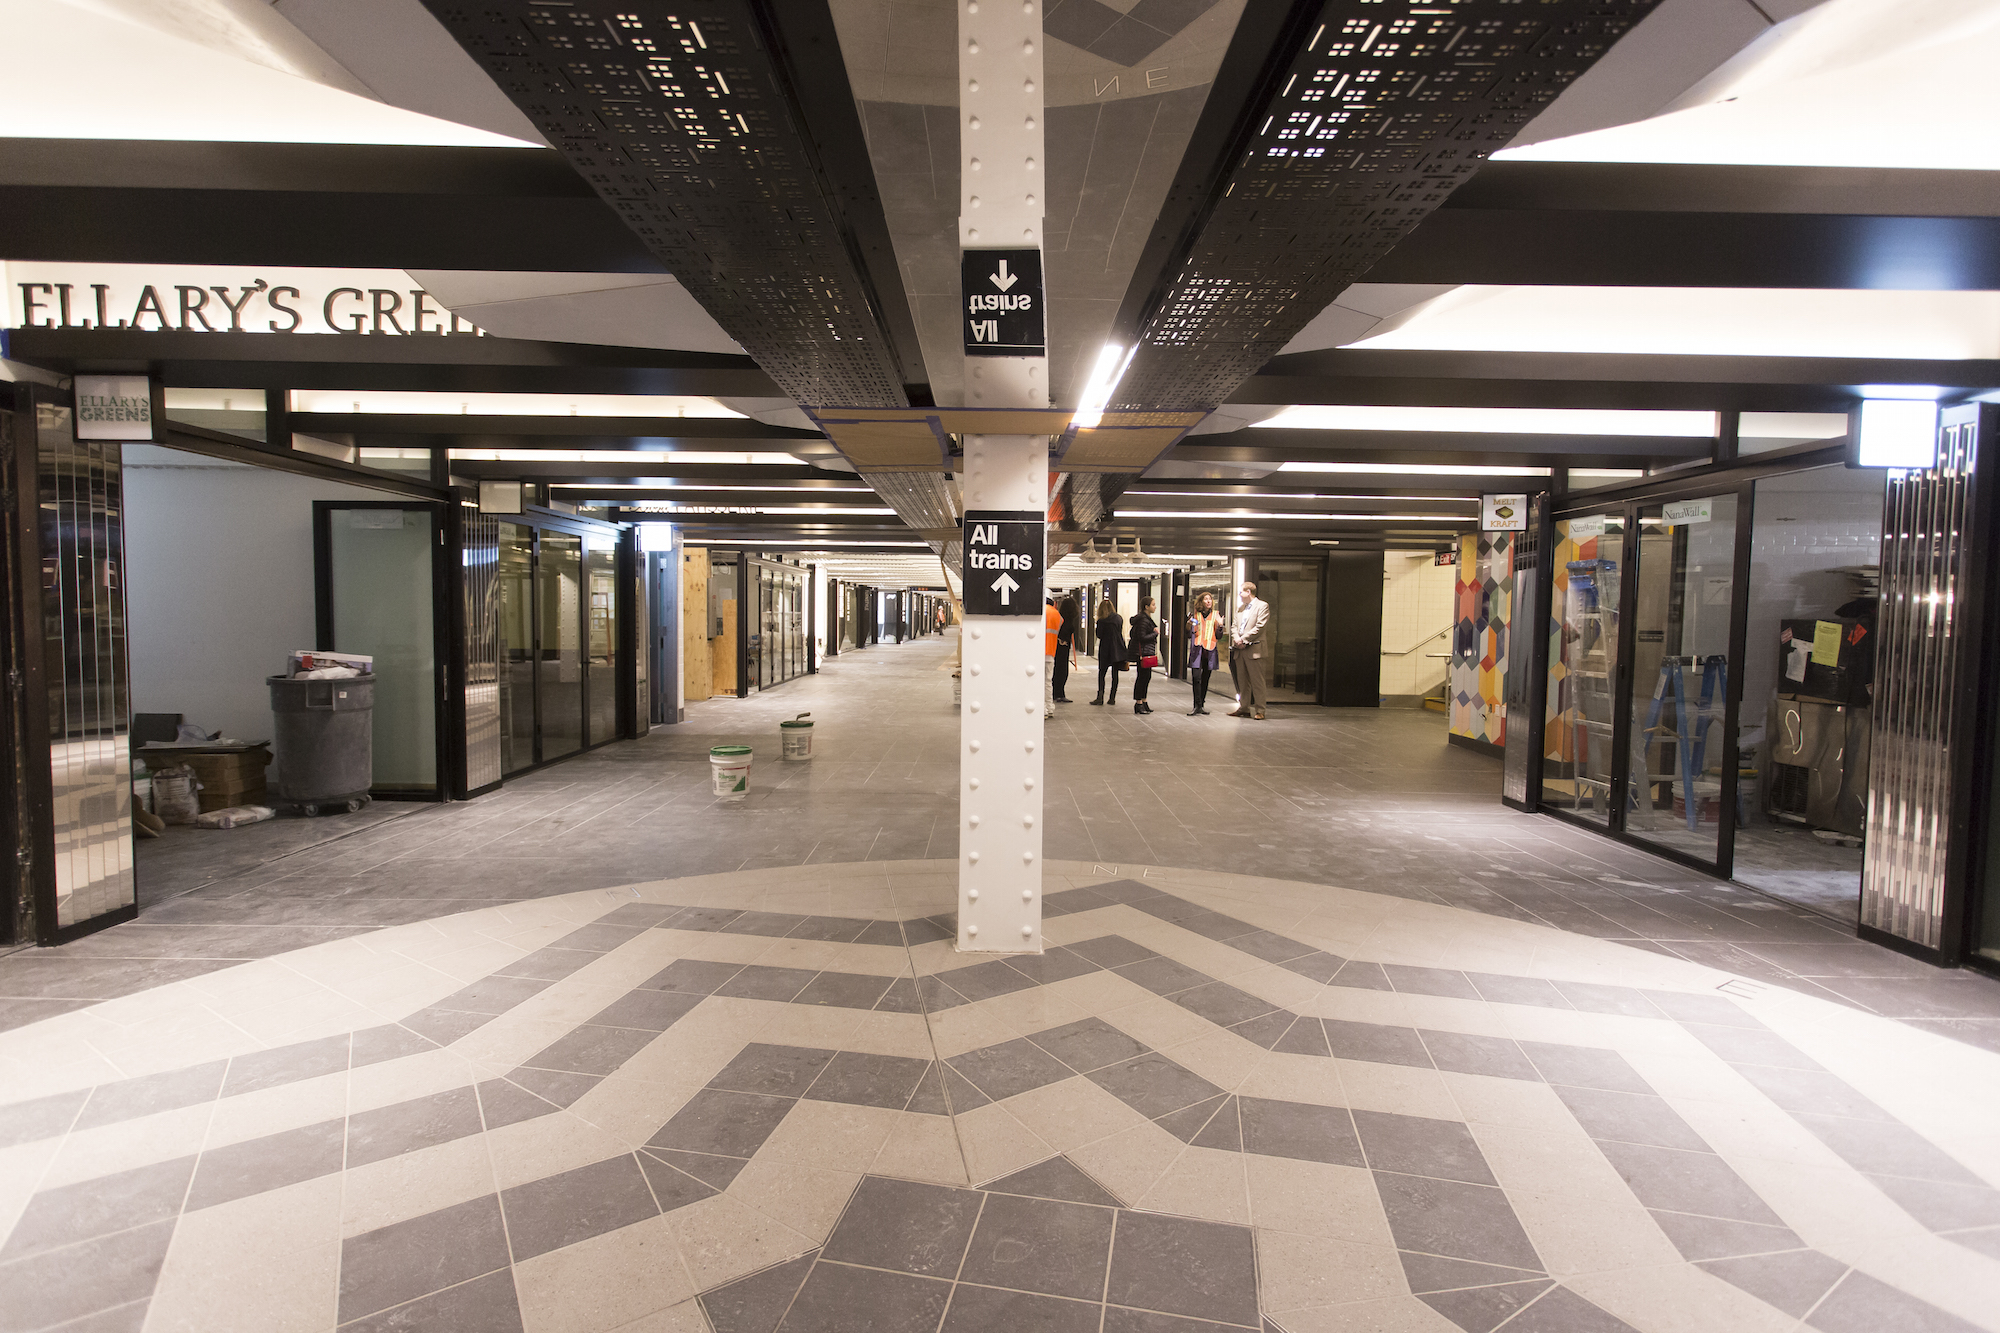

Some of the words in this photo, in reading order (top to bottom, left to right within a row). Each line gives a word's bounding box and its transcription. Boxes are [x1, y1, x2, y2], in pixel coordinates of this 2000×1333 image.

[17, 278, 302, 334] ELLARY'S
[79, 395, 149, 408] ELLARY'S
[80, 407, 150, 422] GREENS
[1492, 498, 1517, 506] MELT
[1664, 506, 1700, 521] NanaWall
[1490, 520, 1518, 528] KRAFT
[969, 524, 998, 545] All
[969, 549, 1033, 570] trains
